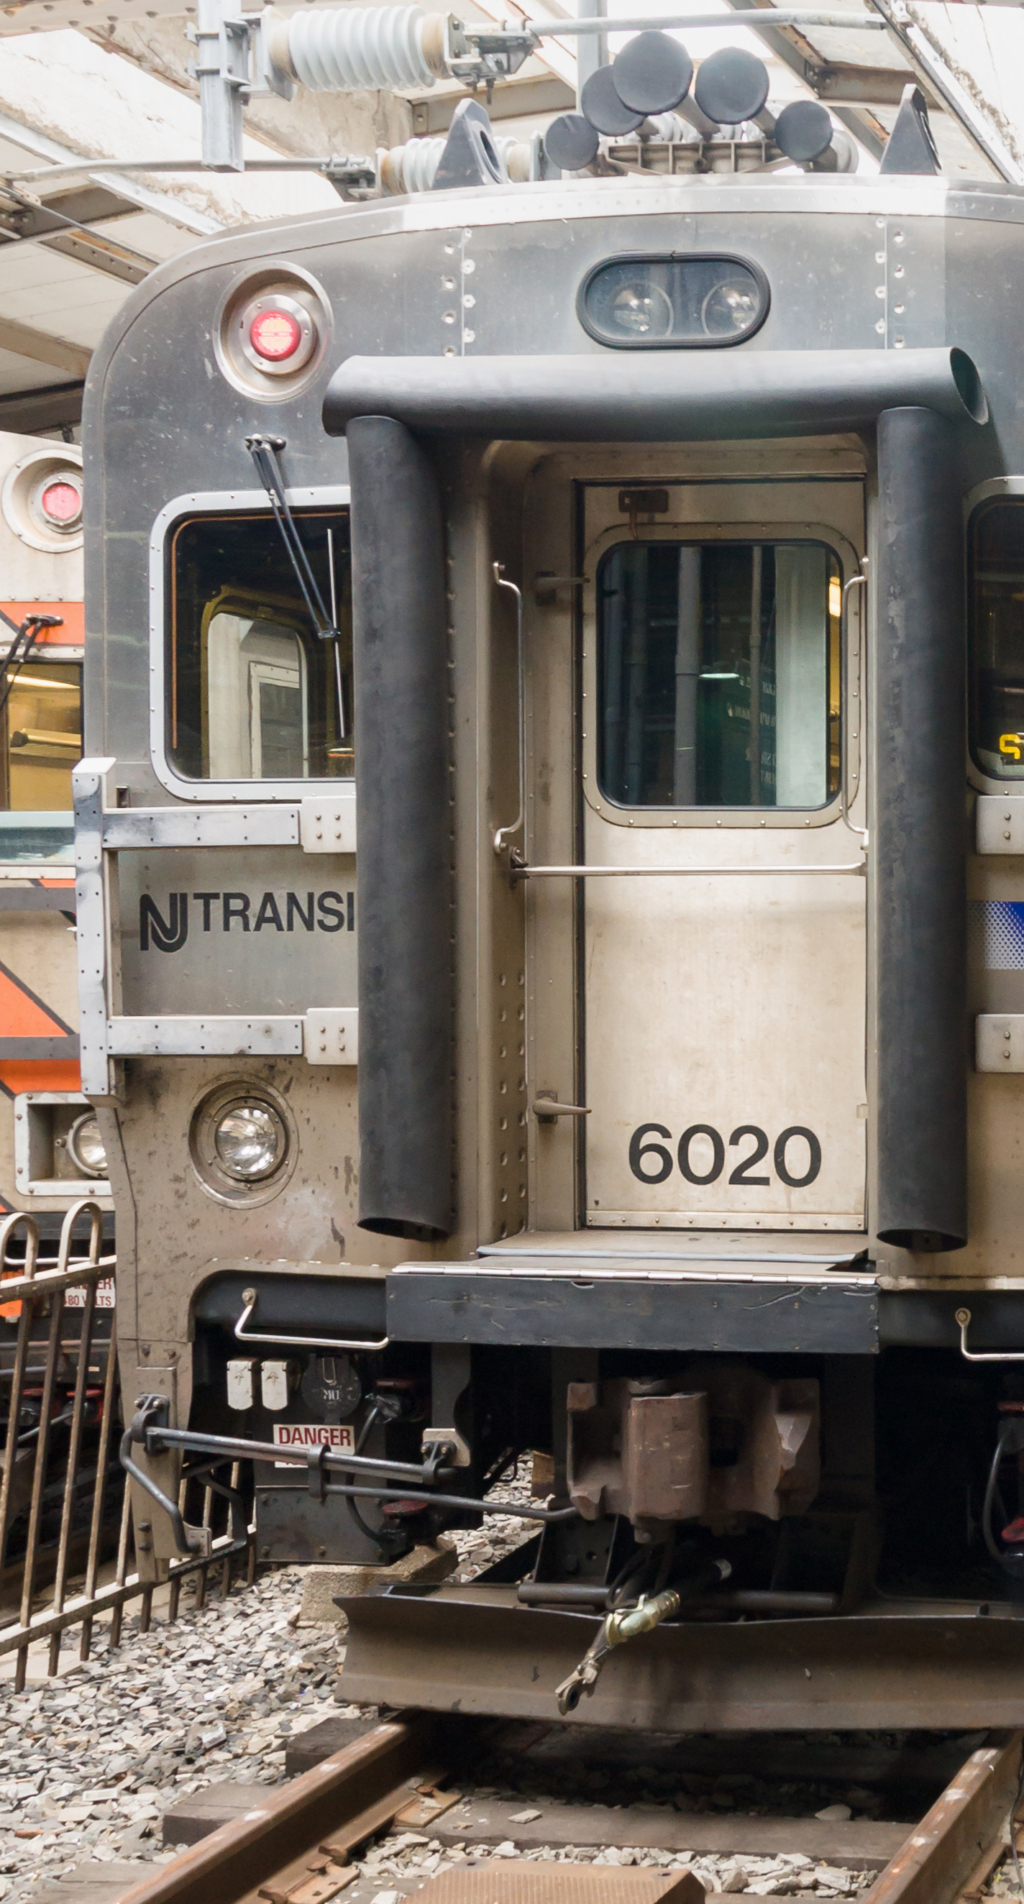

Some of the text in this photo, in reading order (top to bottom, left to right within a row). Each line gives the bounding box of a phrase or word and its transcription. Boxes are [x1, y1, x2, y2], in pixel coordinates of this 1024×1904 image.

[139, 893, 188, 953] NJ
[628, 1122, 822, 1188] 6020
[64, 1294, 80, 1306] 80
[278, 1426, 352, 1447] DANGER
